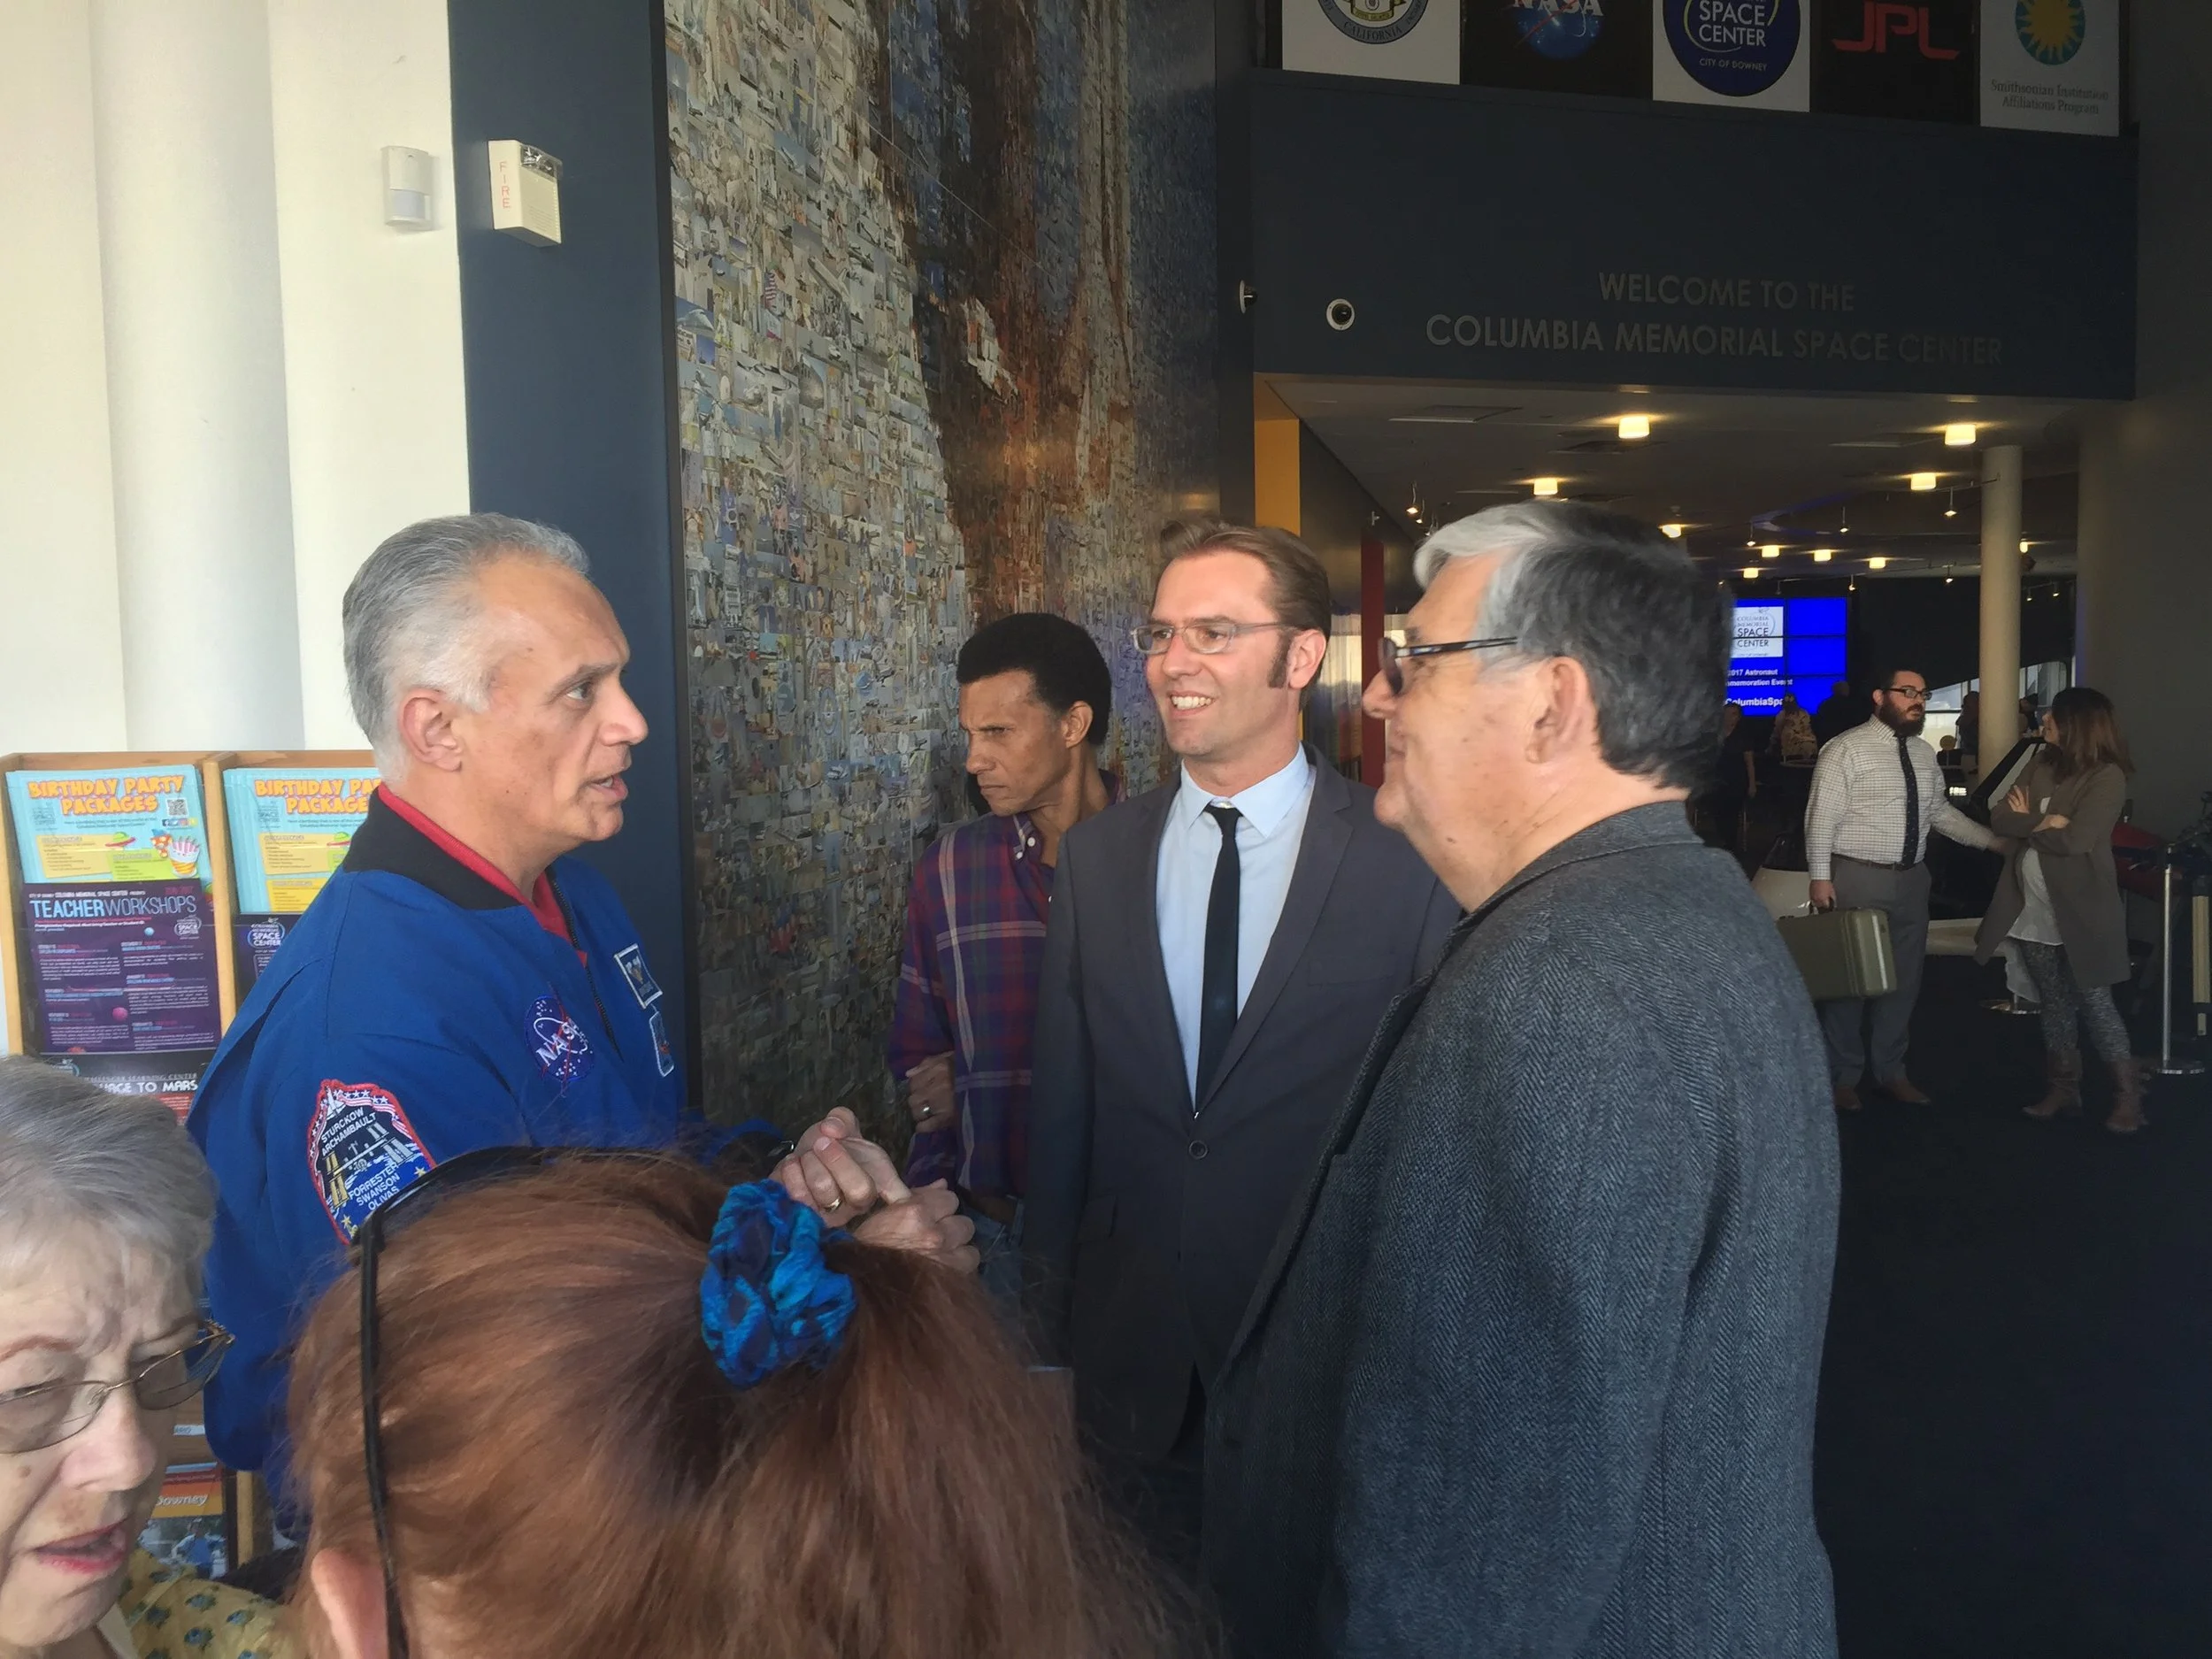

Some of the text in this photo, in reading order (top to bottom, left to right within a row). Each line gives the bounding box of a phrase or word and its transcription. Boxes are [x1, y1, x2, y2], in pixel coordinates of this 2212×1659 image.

[1699, 0, 1766, 26] SPACE
[1344, 21, 1402, 41] CALIFORNIA
[1699, 24, 1767, 47] CENTER
[1830, 0, 1961, 60] JPL
[1699, 58, 1767, 71] CITY OF DOWNEY
[1991, 79, 2108, 101] Smithsonian Institution
[2001, 95, 2100, 115] Affiliations Program
[499, 161, 511, 210] FIRE
[1598, 272, 1855, 311] WELCOME TO THE
[1425, 314, 2003, 366] COLUMBIA MEMORIAL SPACE CENTER
[1737, 627, 1770, 637] SPACE
[1737, 639, 1770, 648] CENTER
[1745, 668, 1778, 677] Astronaut
[27, 775, 185, 799] BIRTHDAY PARTY
[254, 779, 344, 797] BIRTHDAY
[60, 795, 160, 816] PACKAGES
[136, 1081, 157, 1093] TO
[163, 1079, 198, 1093] MARS
[321, 1107, 364, 1143] STURCKOW
[321, 1112, 376, 1156] ARCHAMBAULT
[348, 1162, 399, 1201] FORRESTER
[356, 1172, 400, 1207] SWANSON
[368, 1186, 400, 1210] OLIVAS
